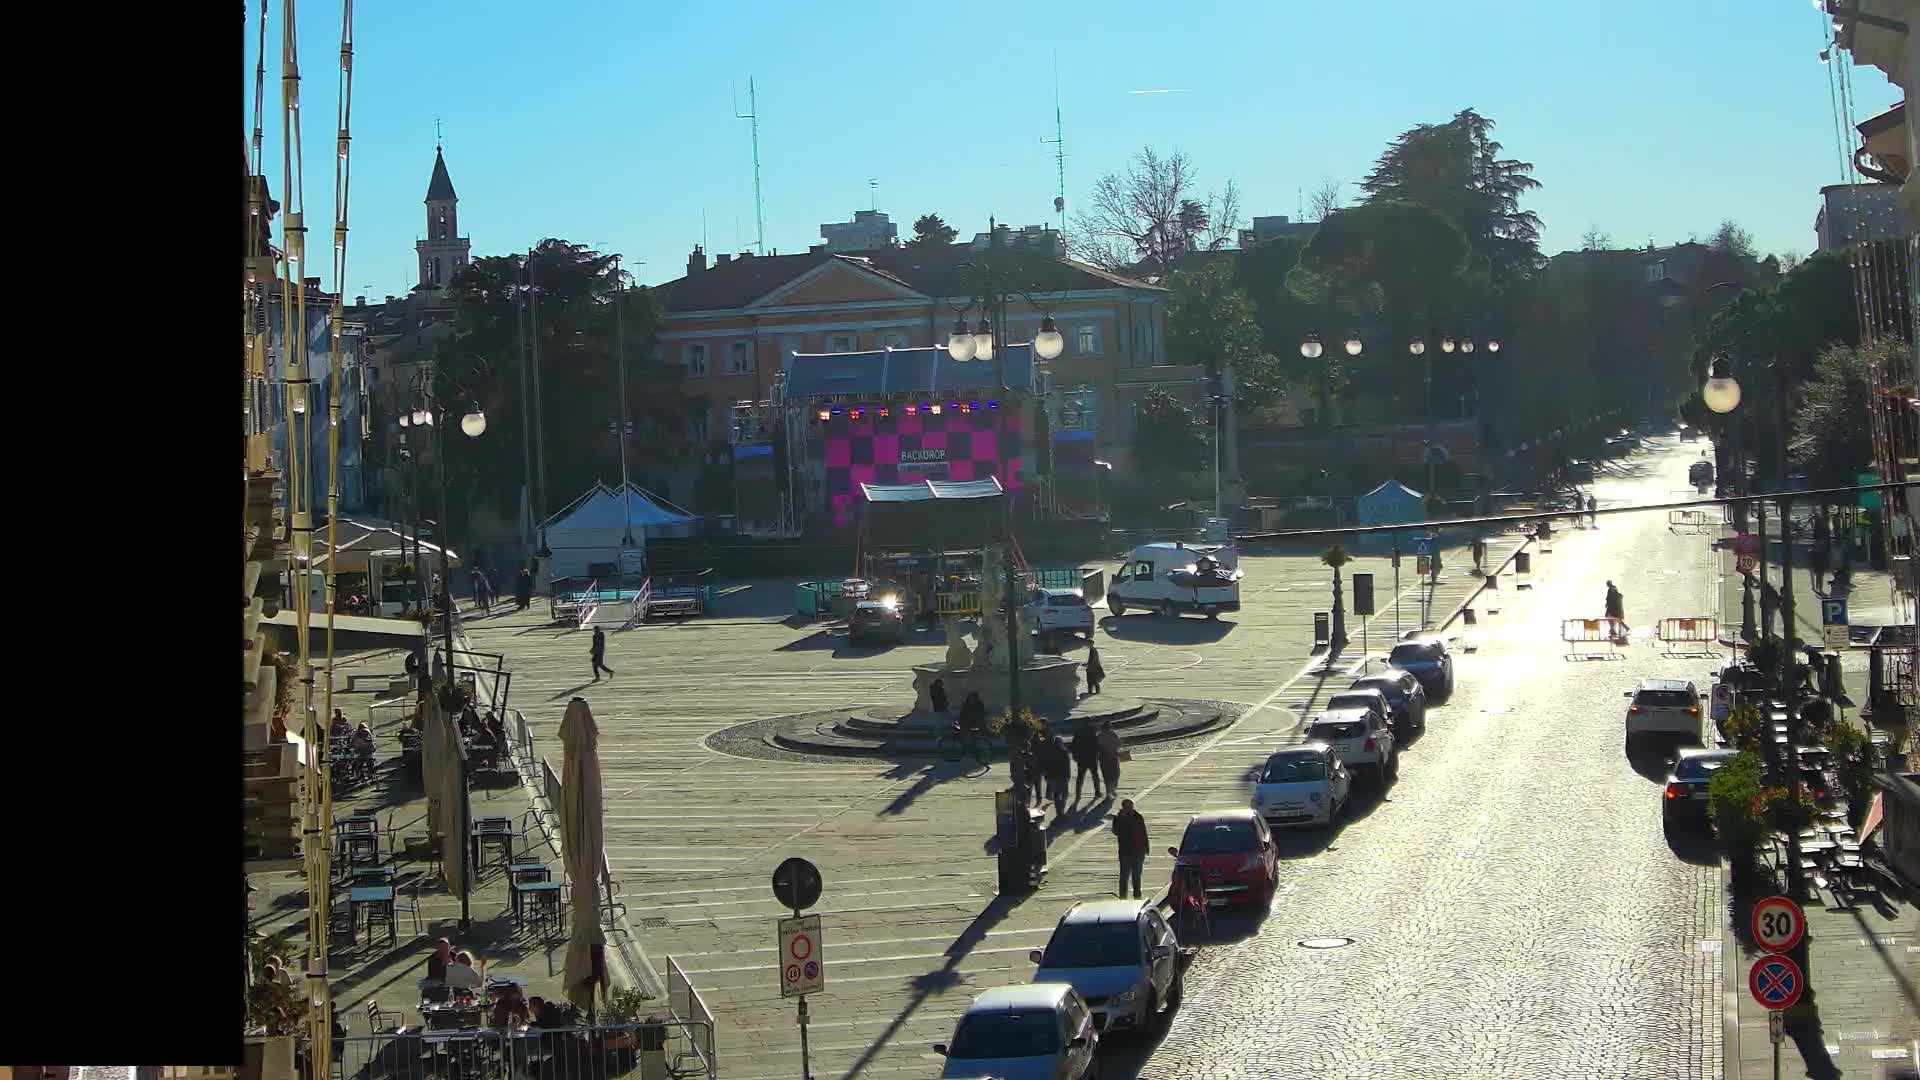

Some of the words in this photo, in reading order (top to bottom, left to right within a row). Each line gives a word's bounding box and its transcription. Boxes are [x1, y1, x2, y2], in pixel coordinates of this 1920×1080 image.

[901, 449, 945, 461] BACKDROP
[1827, 602, 1842, 622] P
[1762, 911, 1792, 938] 30
